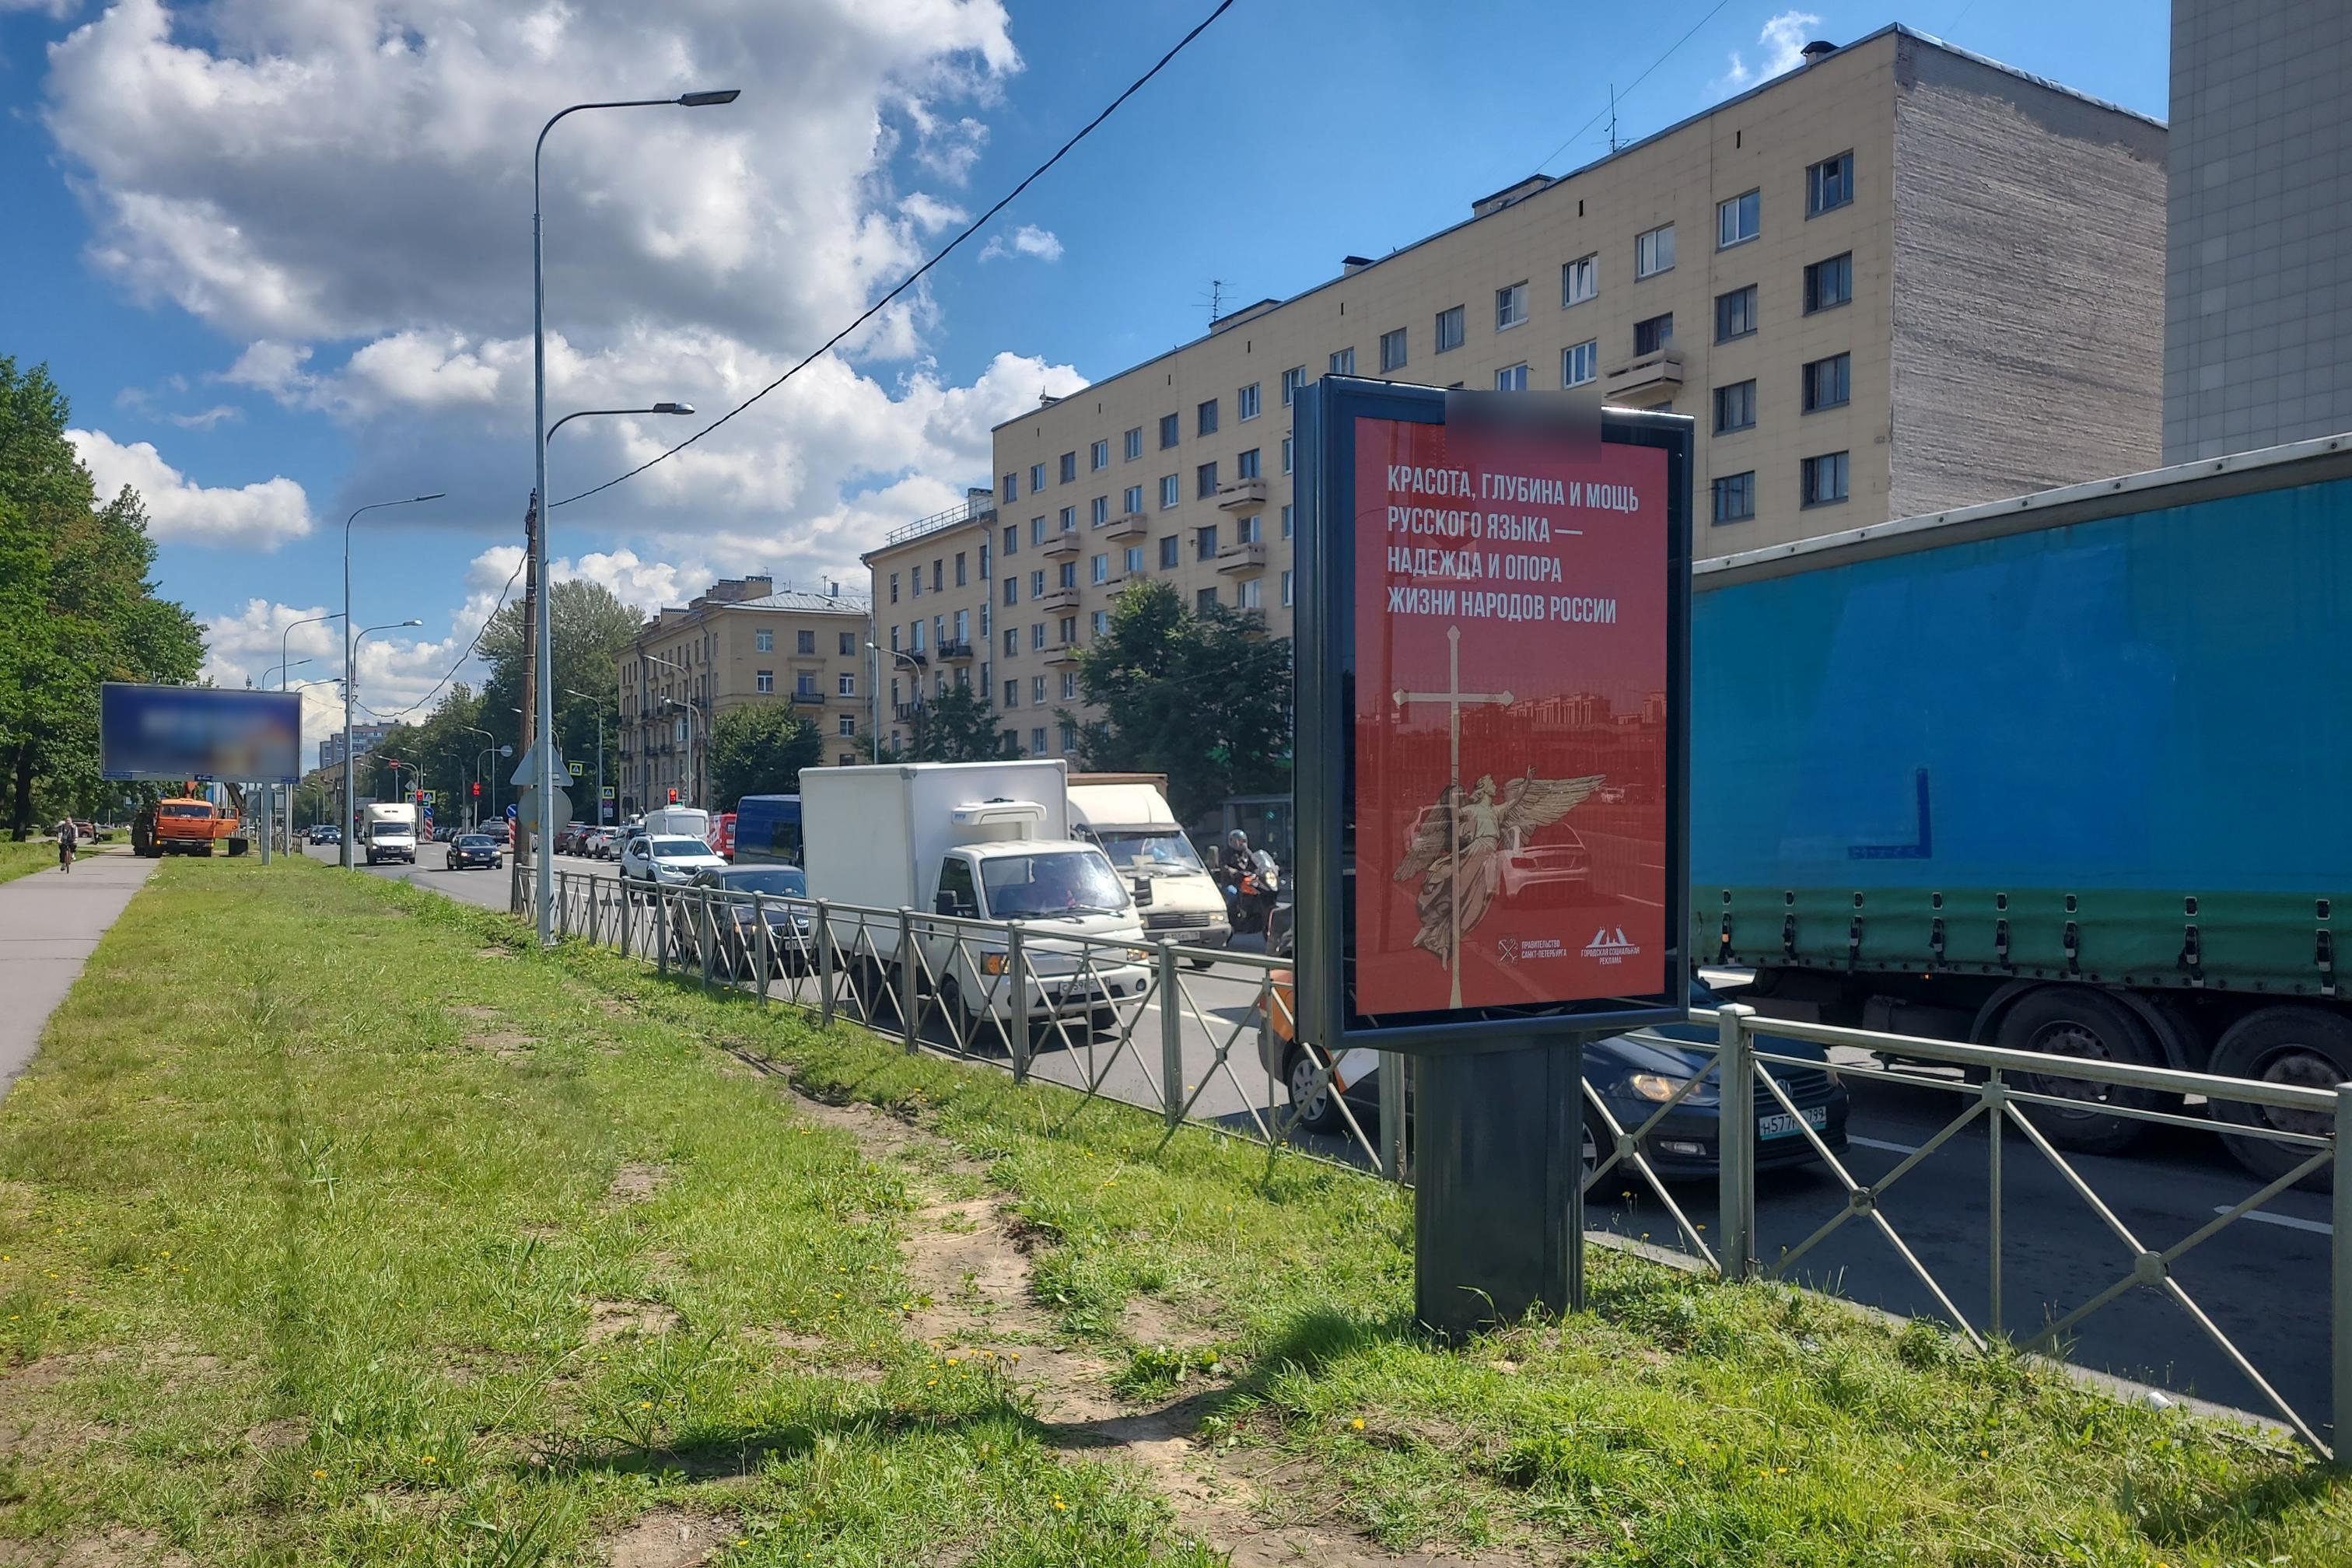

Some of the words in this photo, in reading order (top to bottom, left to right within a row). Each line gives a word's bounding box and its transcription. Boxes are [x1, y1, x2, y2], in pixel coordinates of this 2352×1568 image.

[1388, 464, 1476, 502] КРАСОТА,
[1482, 473, 1565, 506] ГЛУБИНА
[1570, 481, 1580, 507] И
[1586, 483, 1639, 514] МОЩЬ
[1388, 506, 1482, 538] РУССКОГО
[1487, 513, 1550, 543] ЯЗЫКА
[1388, 546, 1483, 580] НАДЕЖДА
[1488, 553, 1500, 579] И
[1505, 554, 1563, 583] ОПОРА
[1387, 586, 1455, 617] ЖИЗНИ
[1461, 590, 1545, 622] НАРОДОВ
[1550, 596, 1616, 624] РОССИИ
[1521, 939, 1560, 950] ПРАВИТЕЛЬСТВО
[1521, 949, 1567, 959] САНКТ-ПЕТЕРБУРГА
[1580, 948, 1608, 957] ГОРОДСКАЯ
[1608, 946, 1640, 956] СОЦИАЛЬНАЯ
[1599, 956, 1622, 965] РЕКЛАМА
